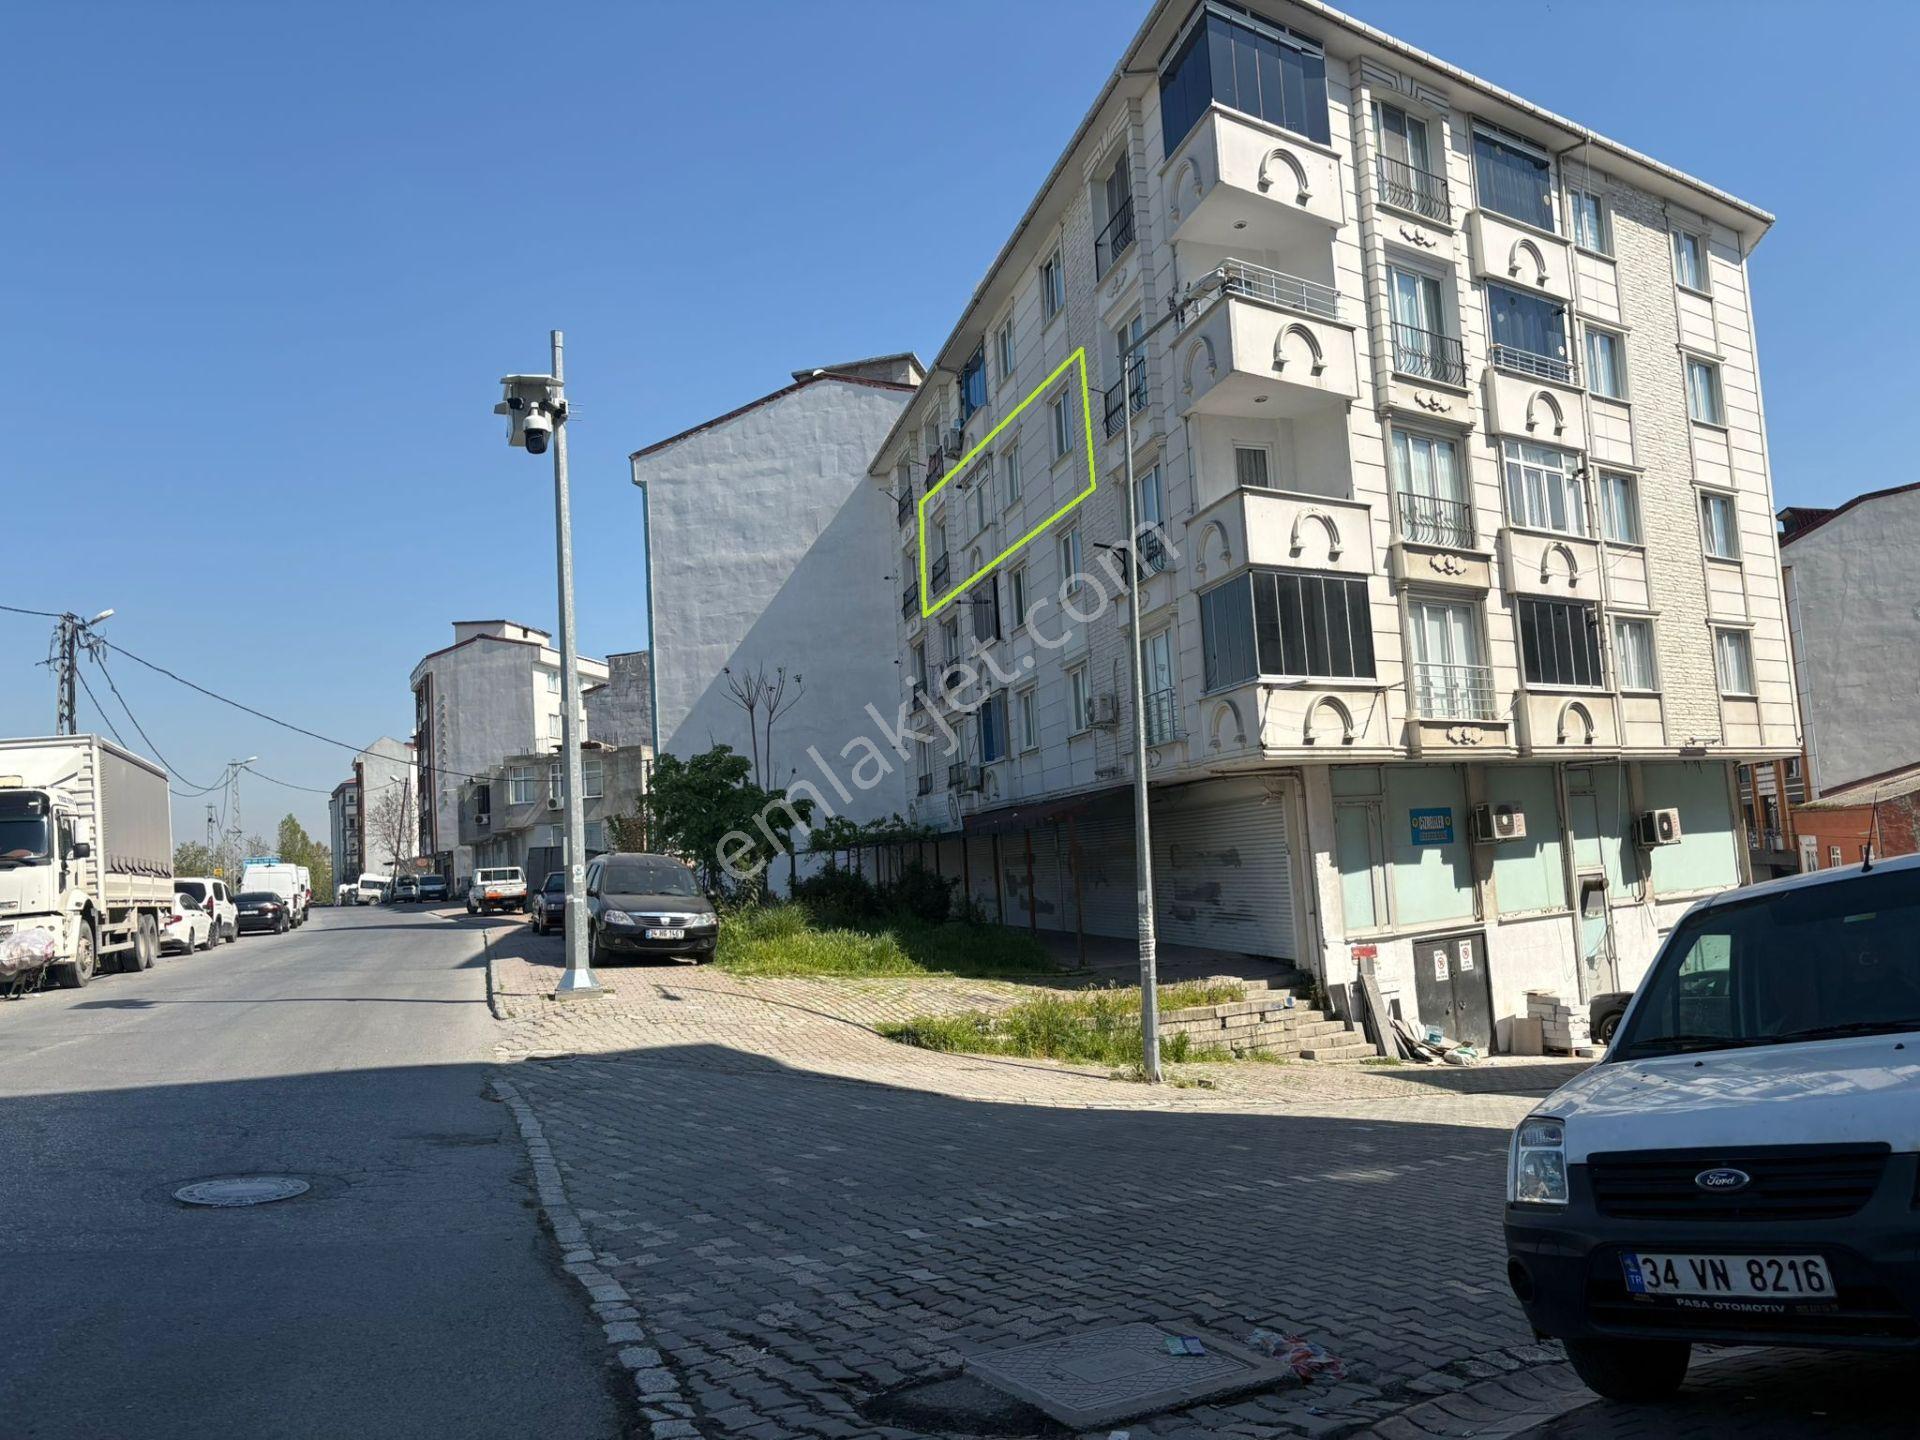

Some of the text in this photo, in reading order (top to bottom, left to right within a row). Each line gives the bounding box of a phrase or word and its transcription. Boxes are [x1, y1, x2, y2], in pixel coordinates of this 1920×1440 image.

[1706, 1173, 1736, 1186] Ford
[1630, 1274, 1642, 1285] TR
[1641, 1257, 1826, 1293] 34 VN 8216
